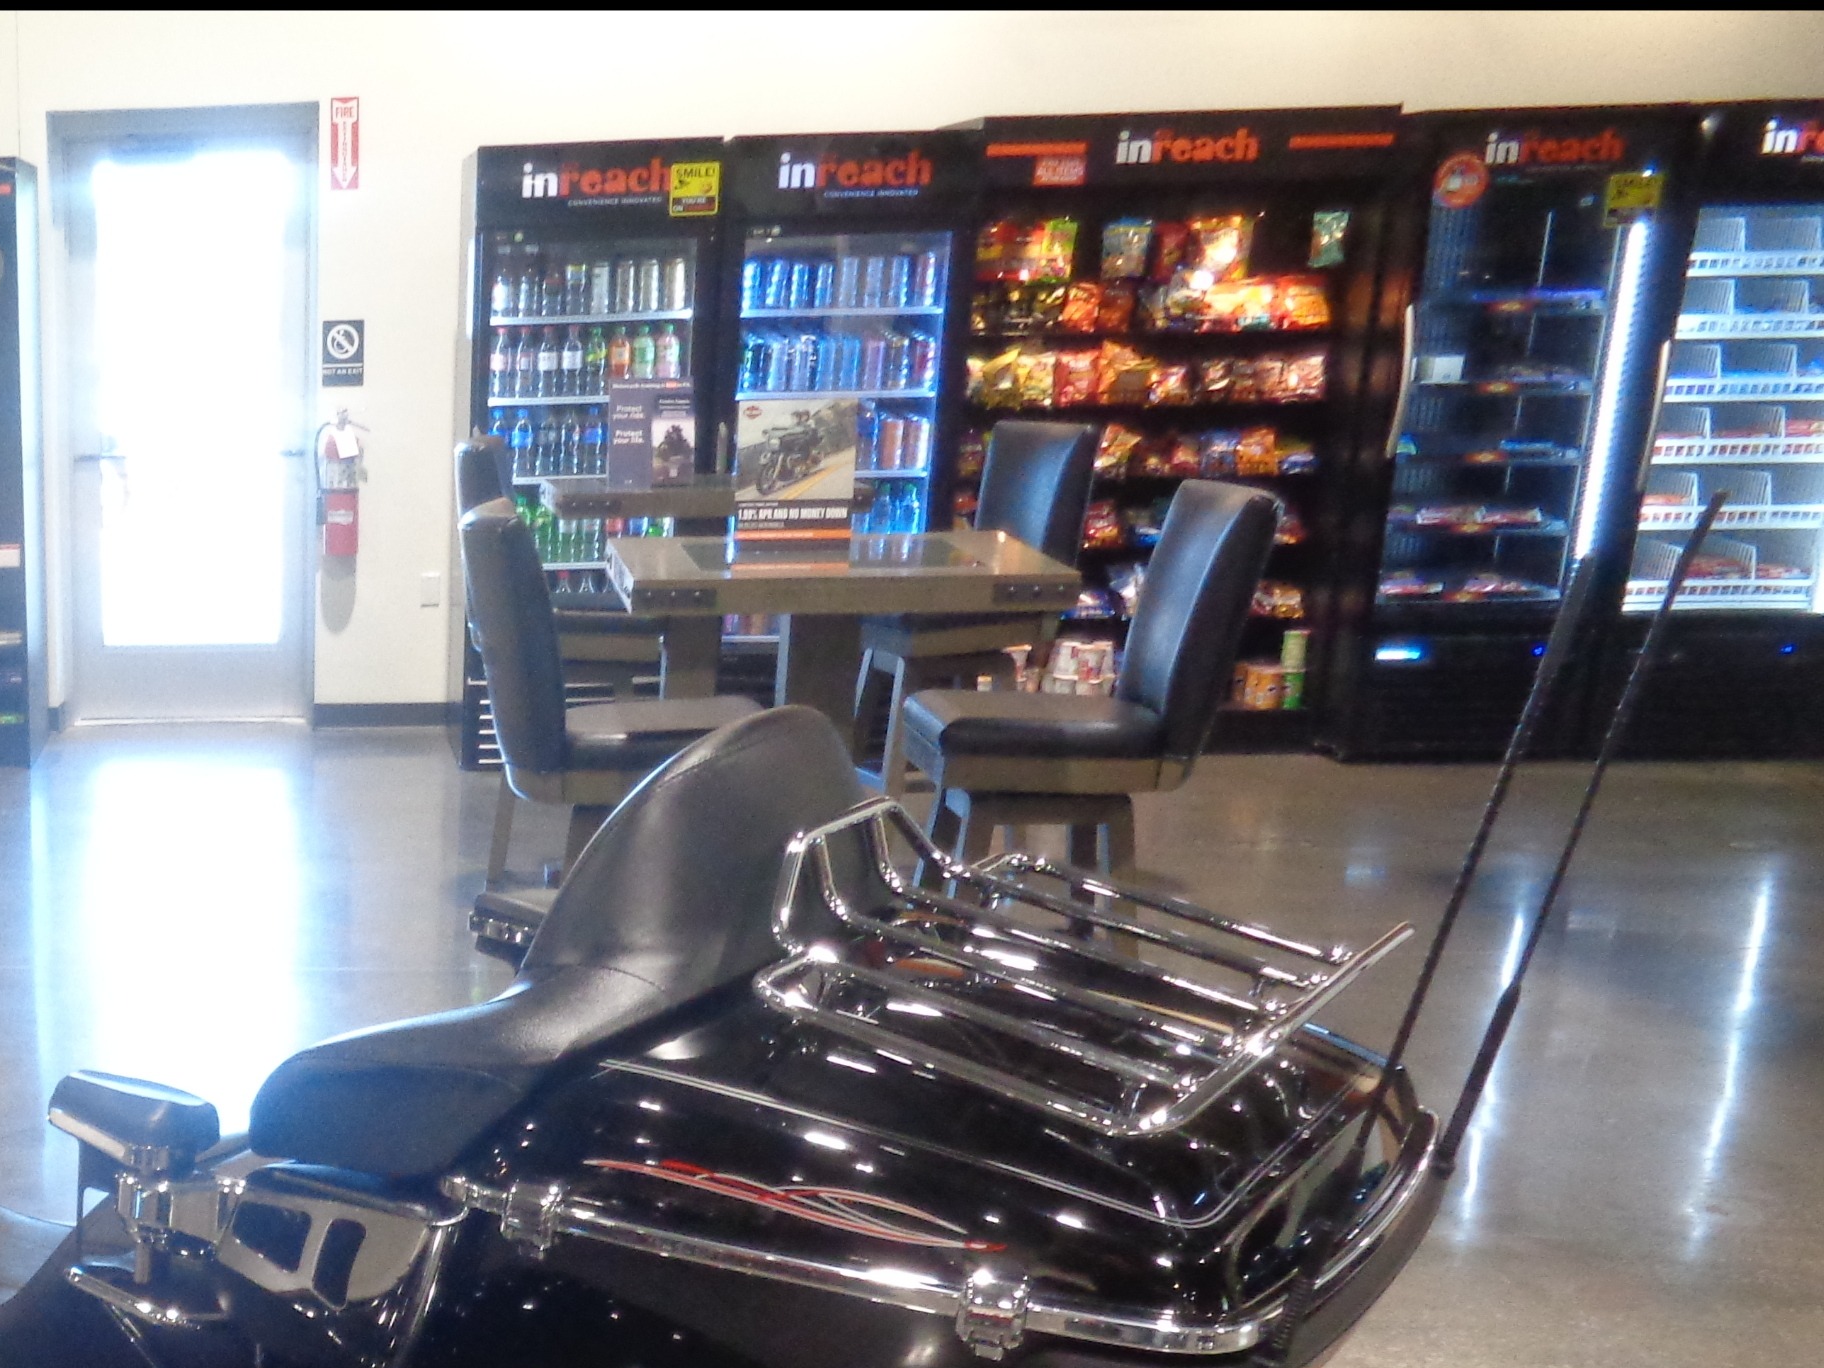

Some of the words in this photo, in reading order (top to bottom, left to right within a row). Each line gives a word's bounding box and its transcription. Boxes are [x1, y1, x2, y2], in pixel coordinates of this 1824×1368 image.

[336, 106, 354, 118] FIRE
[1116, 127, 1259, 164] inreach
[1485, 128, 1625, 165] inreach
[522, 157, 672, 198] inreach
[778, 150, 933, 189] inreach
[773, 508, 788, 520] AND
[788, 508, 800, 519] NO
[800, 507, 826, 519] MONEY
